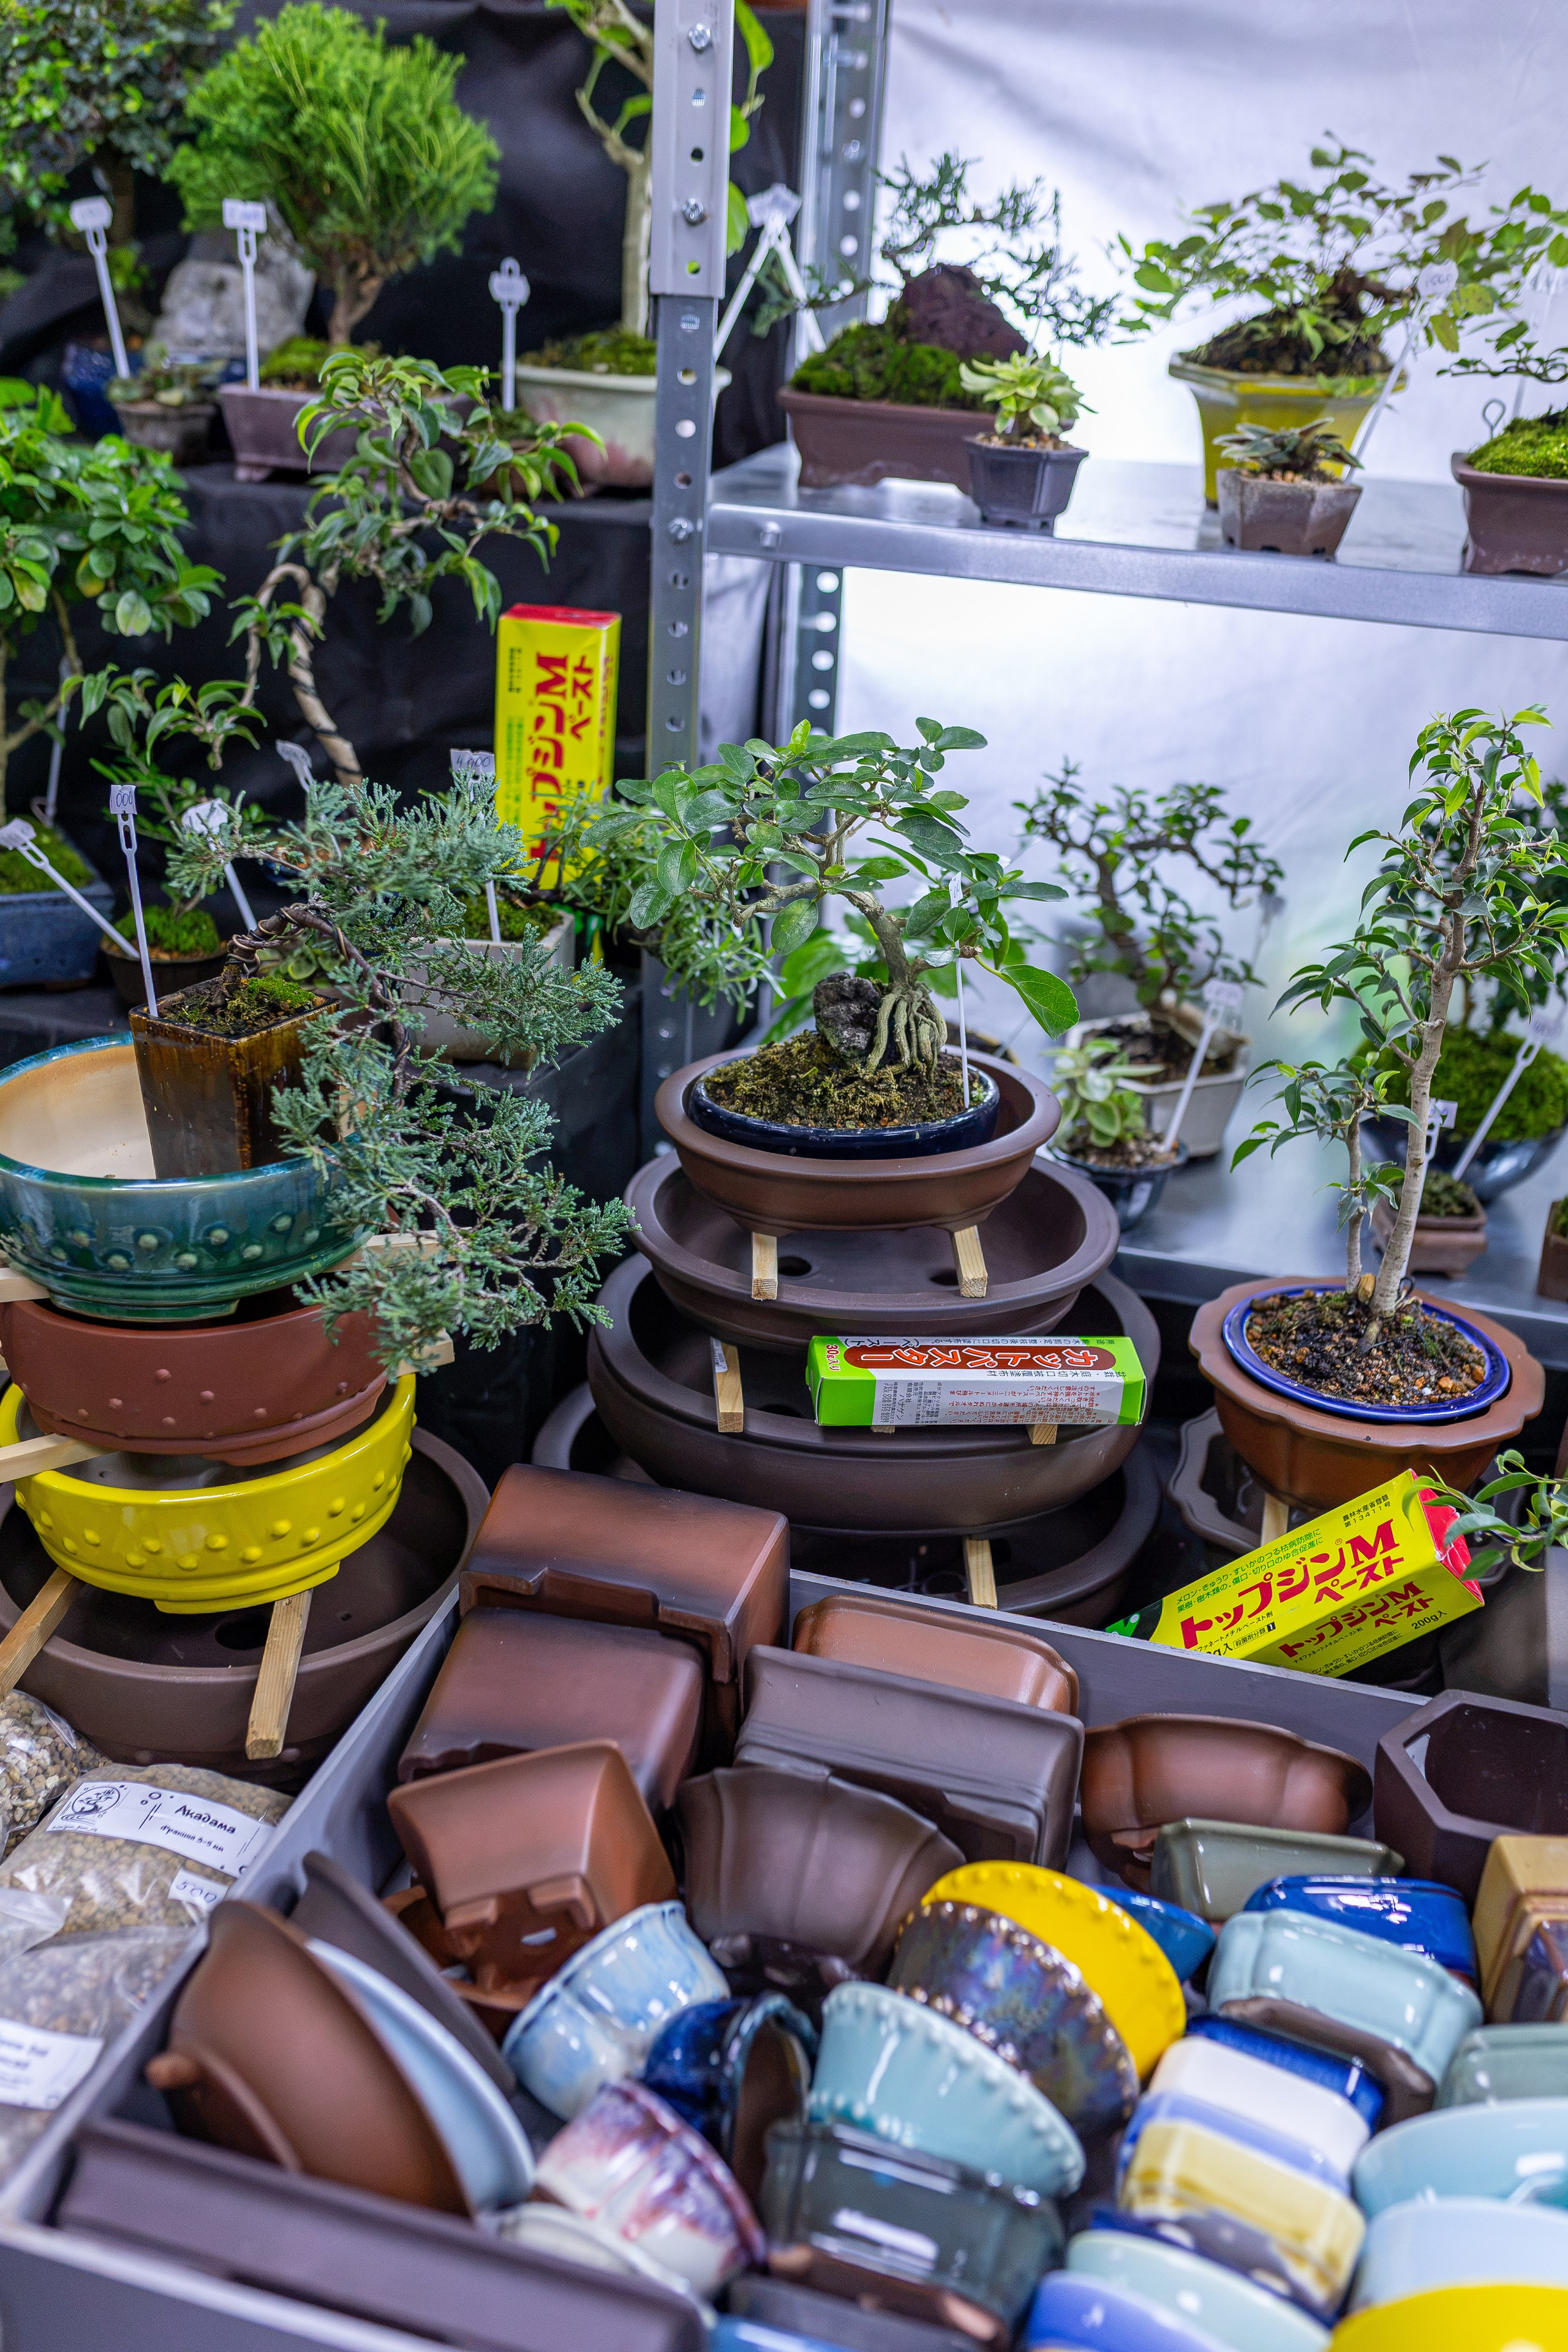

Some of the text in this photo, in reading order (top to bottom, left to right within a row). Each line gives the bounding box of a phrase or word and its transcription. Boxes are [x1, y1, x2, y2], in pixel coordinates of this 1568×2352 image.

[569, 655, 594, 741] ペースト
[861, 1347, 1099, 1370] カットパスター
[896, 1394, 905, 1421] ハナゲン
[1314, 1555, 1404, 1604] ペースト
[1278, 1580, 1425, 1658] トップジンM
[1374, 1597, 1434, 1629] ペースト
[1411, 1610, 1448, 1630] 200g入
[1194, 1610, 1273, 1652] ファネートメチルペースト剤
[1205, 1643, 1234, 1656] g入
[175, 1805, 236, 1834] Акадама
